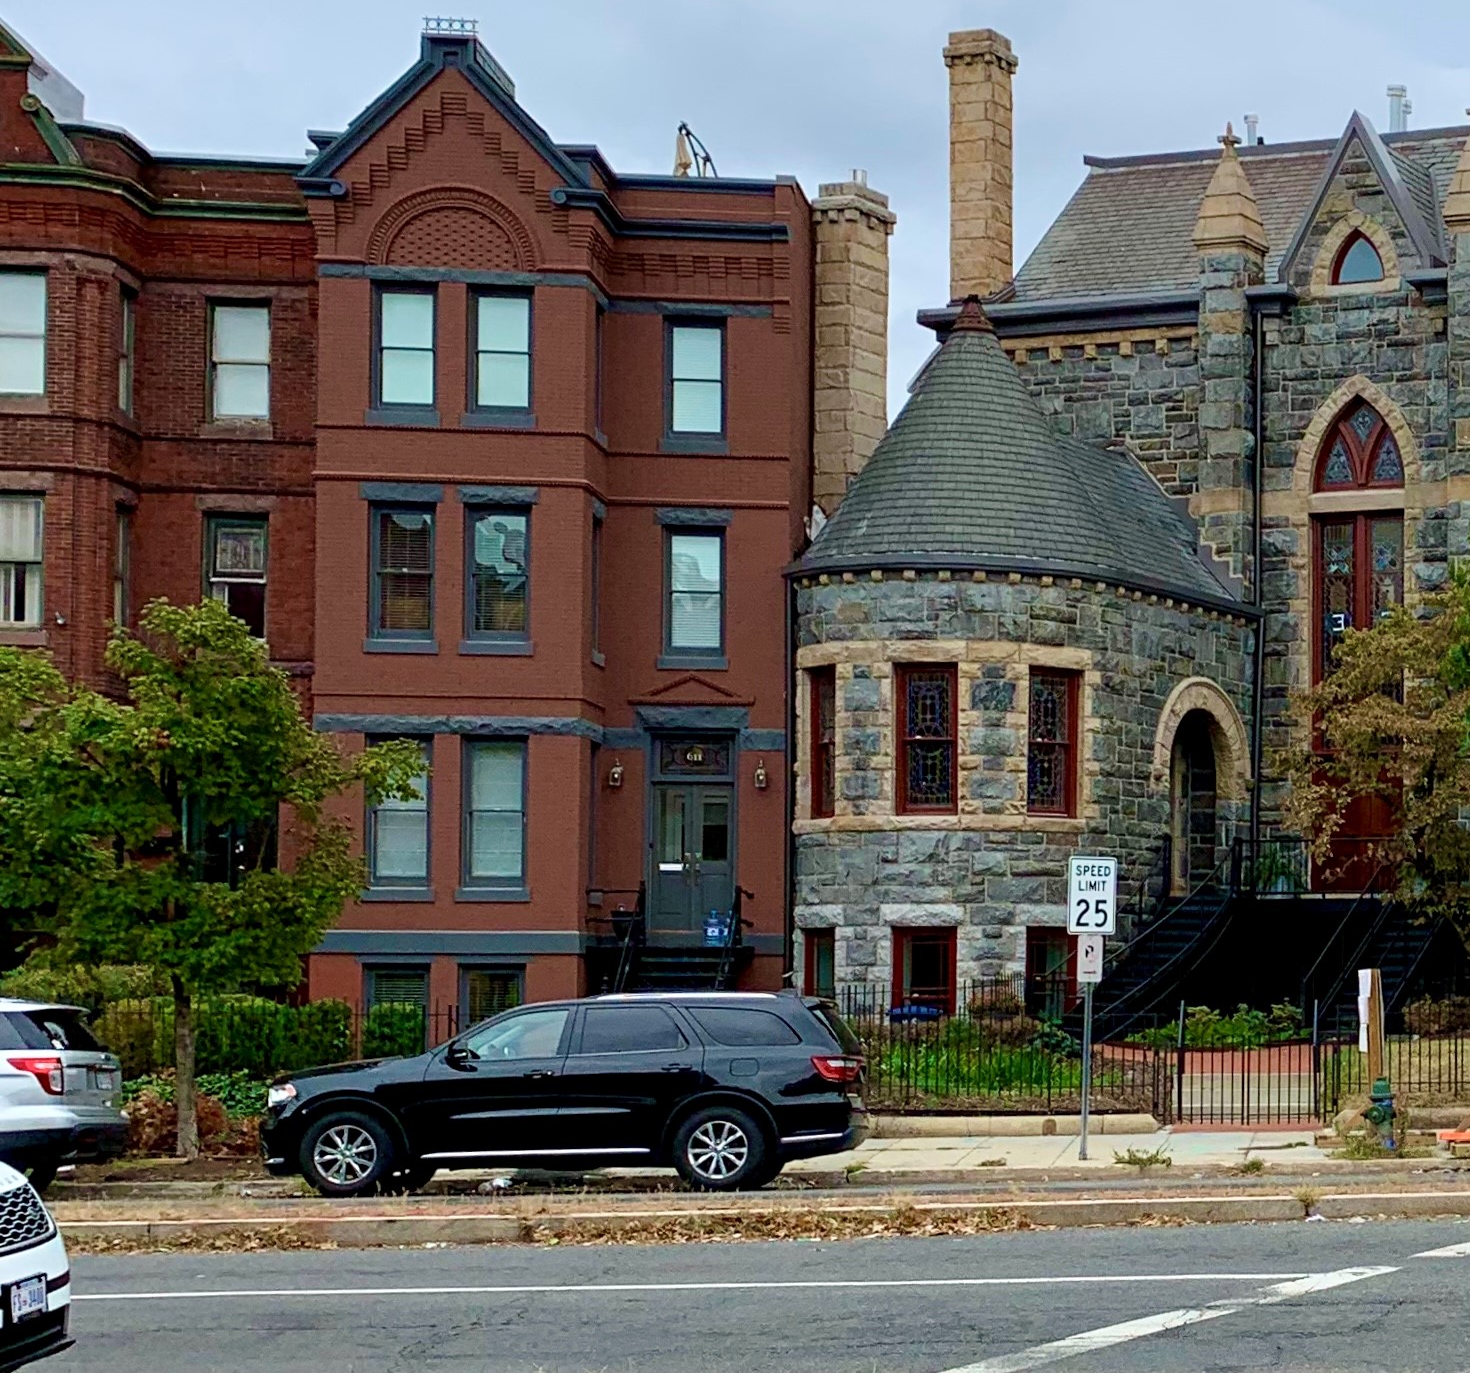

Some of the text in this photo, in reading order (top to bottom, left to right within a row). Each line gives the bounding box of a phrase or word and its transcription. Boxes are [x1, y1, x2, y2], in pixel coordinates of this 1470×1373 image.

[686, 752, 702, 761] 611
[1075, 865, 1111, 877] SPEED
[1078, 880, 1107, 892] LIMIT
[1075, 898, 1108, 928] 25
